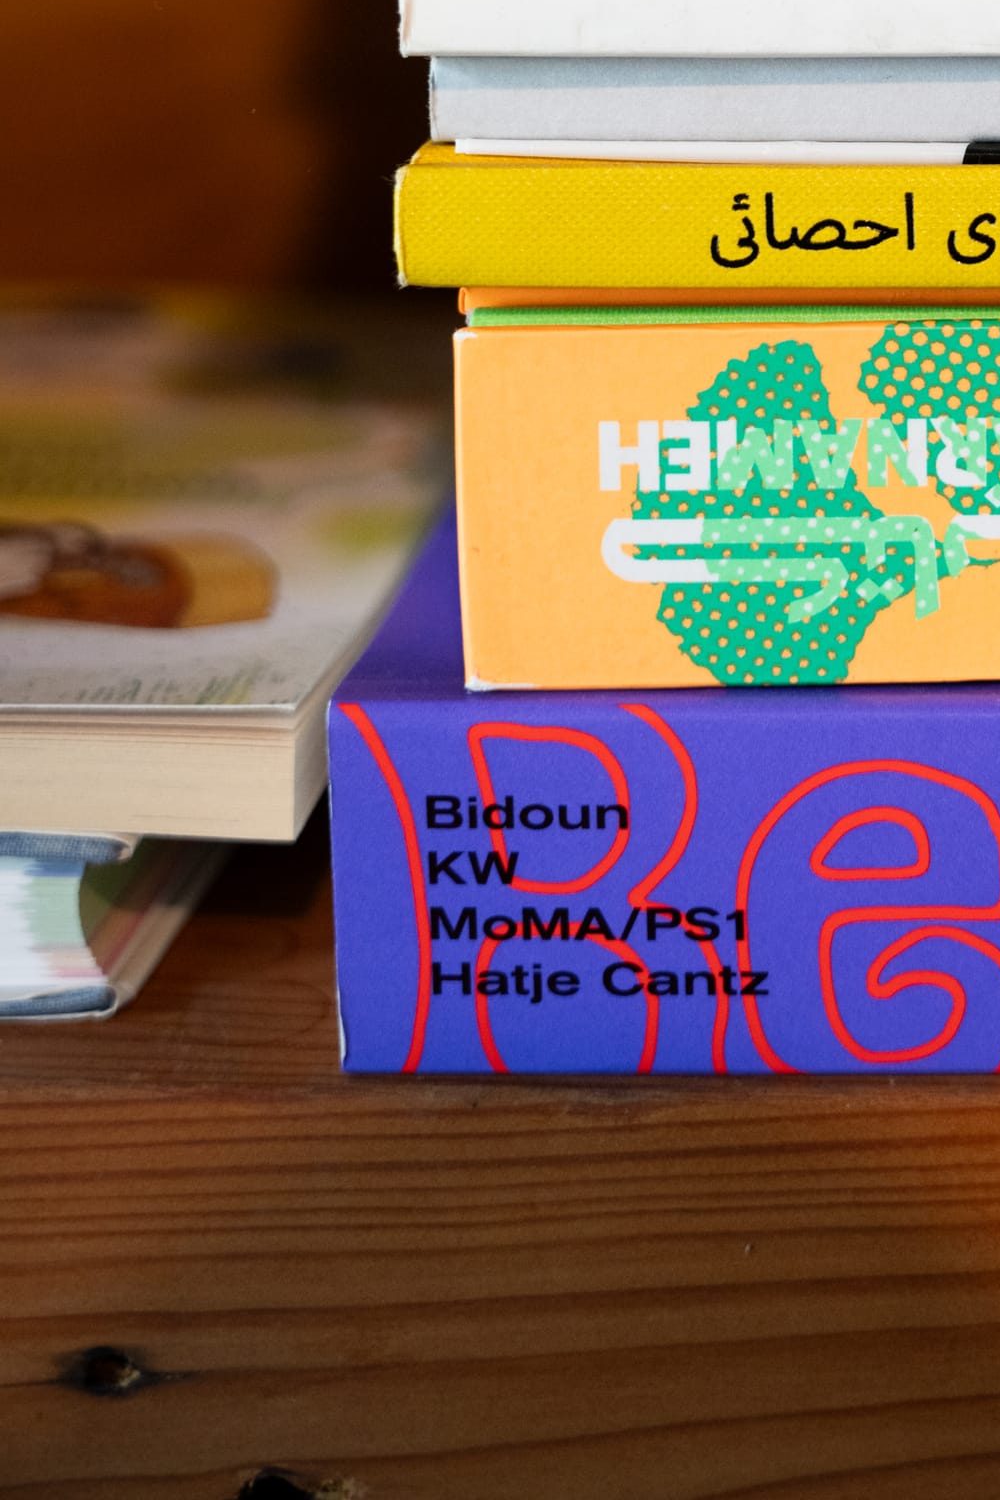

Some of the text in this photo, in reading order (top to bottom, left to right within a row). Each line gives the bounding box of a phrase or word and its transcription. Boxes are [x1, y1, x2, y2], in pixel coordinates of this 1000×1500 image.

[426, 795, 630, 830] Bidoun
[427, 851, 519, 885] KW
[430, 907, 747, 941] MoMA/PS1
[432, 963, 770, 1004] Hatje Cantz
